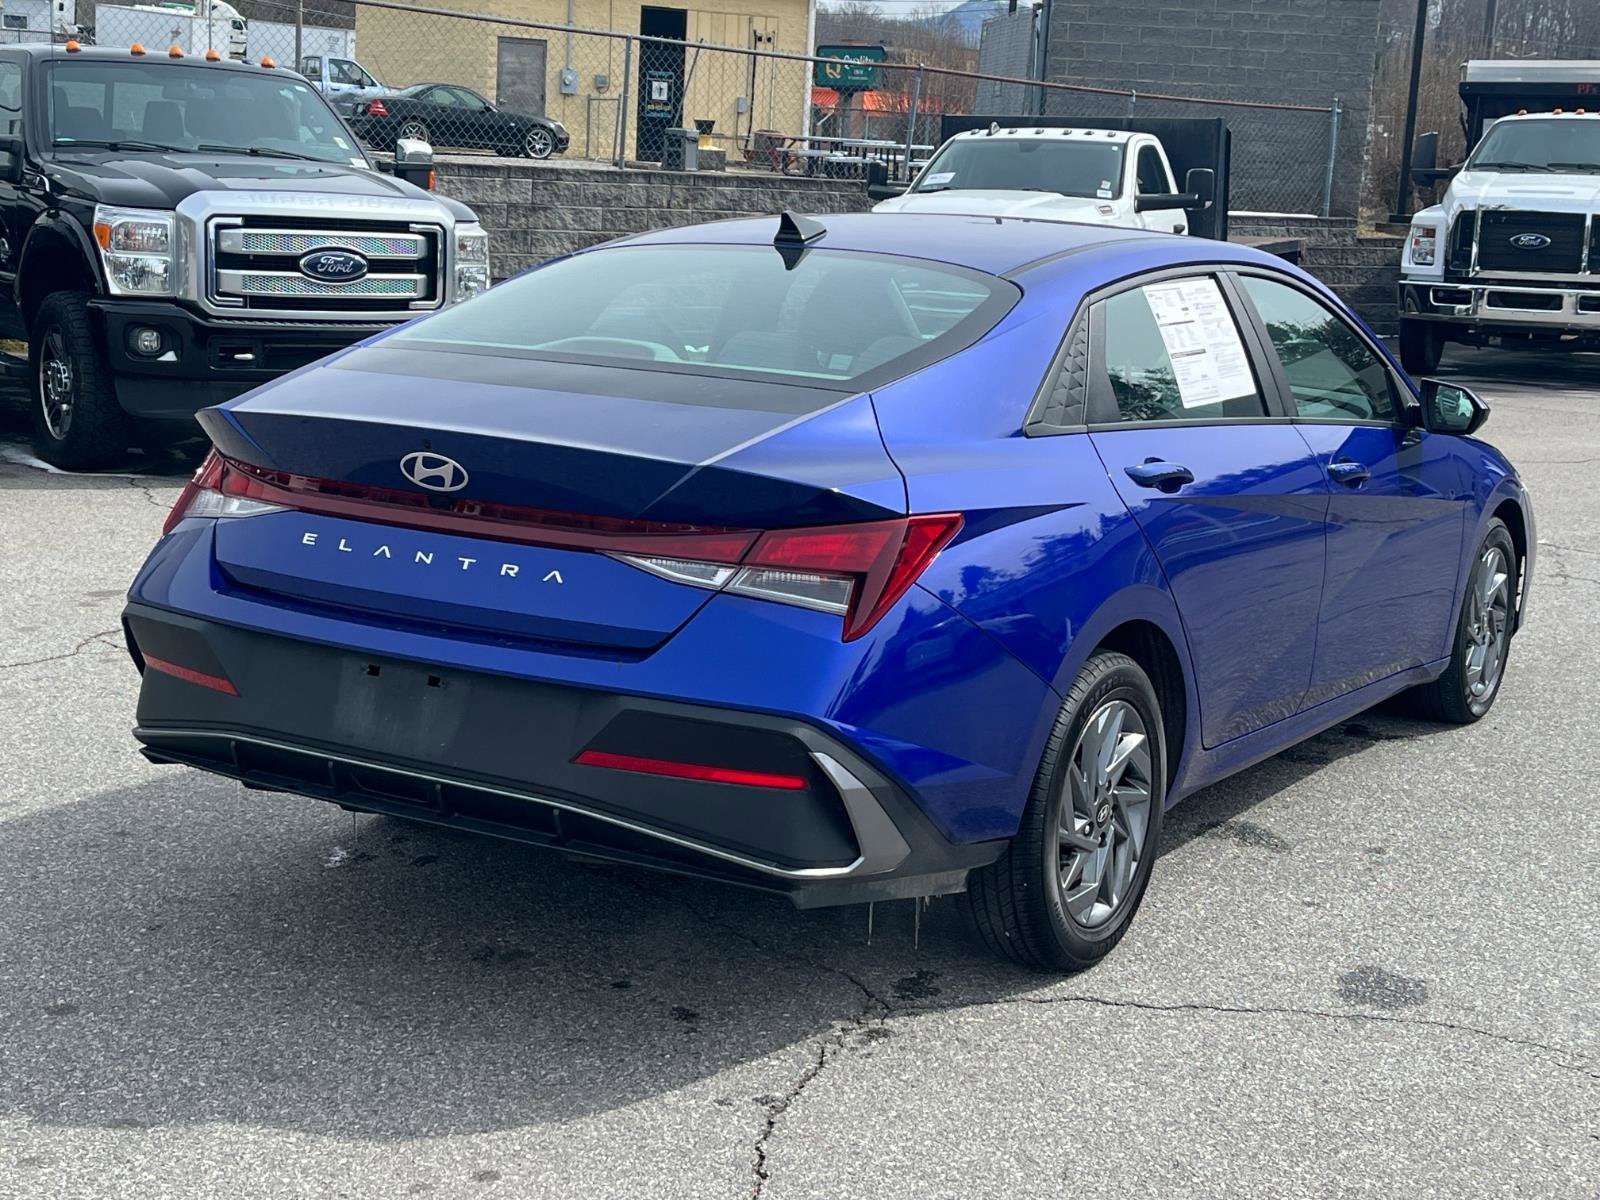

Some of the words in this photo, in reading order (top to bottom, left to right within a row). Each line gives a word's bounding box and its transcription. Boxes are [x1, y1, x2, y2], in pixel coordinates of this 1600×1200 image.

[1518, 235, 1541, 246] Ford
[317, 254, 353, 274] Ford
[301, 532, 564, 584] ELANTRA
